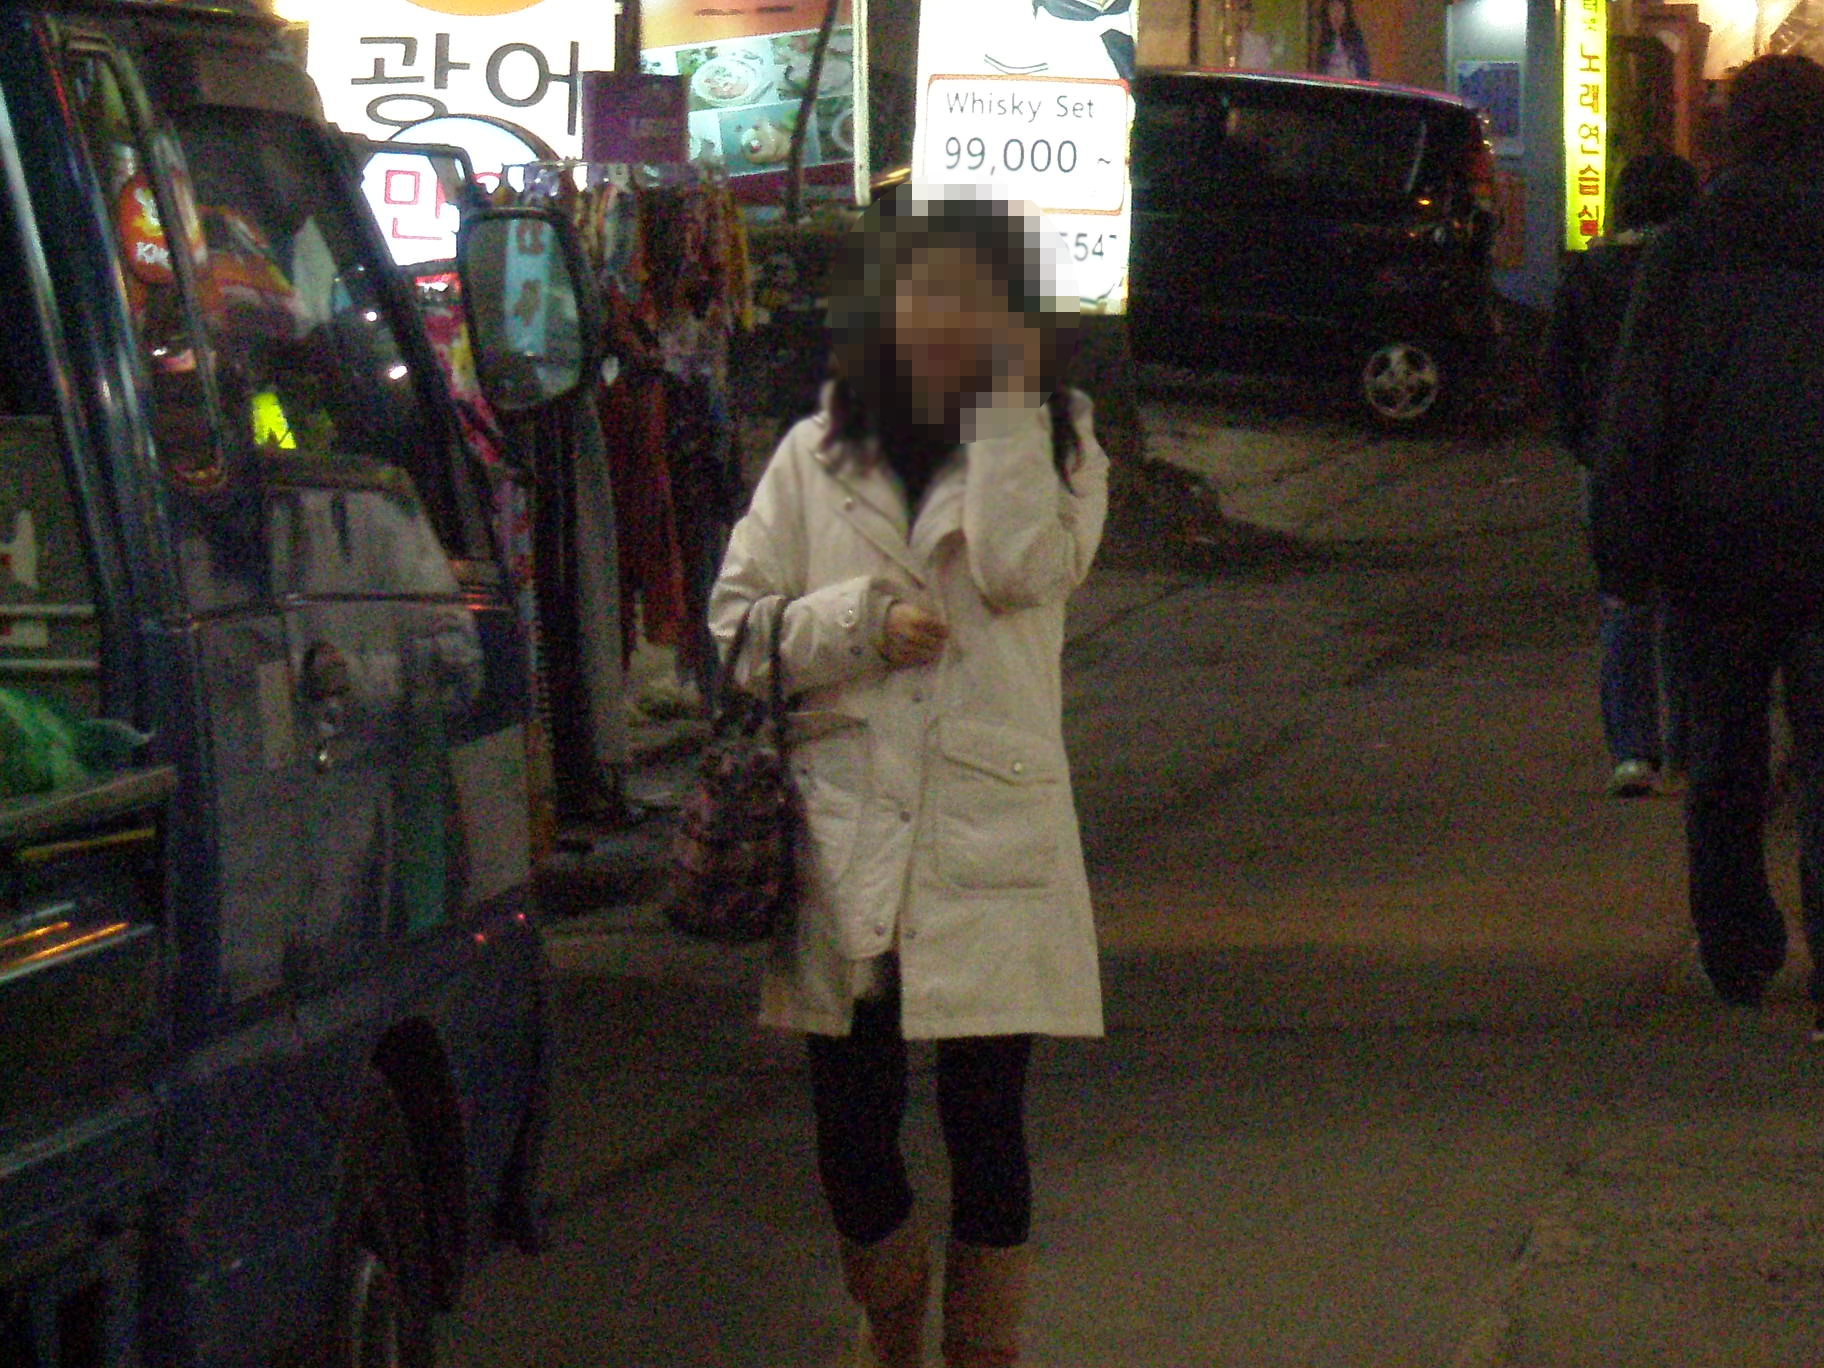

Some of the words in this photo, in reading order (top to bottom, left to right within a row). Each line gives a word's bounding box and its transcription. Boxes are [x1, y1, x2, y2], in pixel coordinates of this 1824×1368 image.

[350, 34, 584, 136] 광어
[947, 92, 1041, 122] Whisky
[1056, 94, 1095, 119] Set
[945, 136, 1077, 175] 99,000
